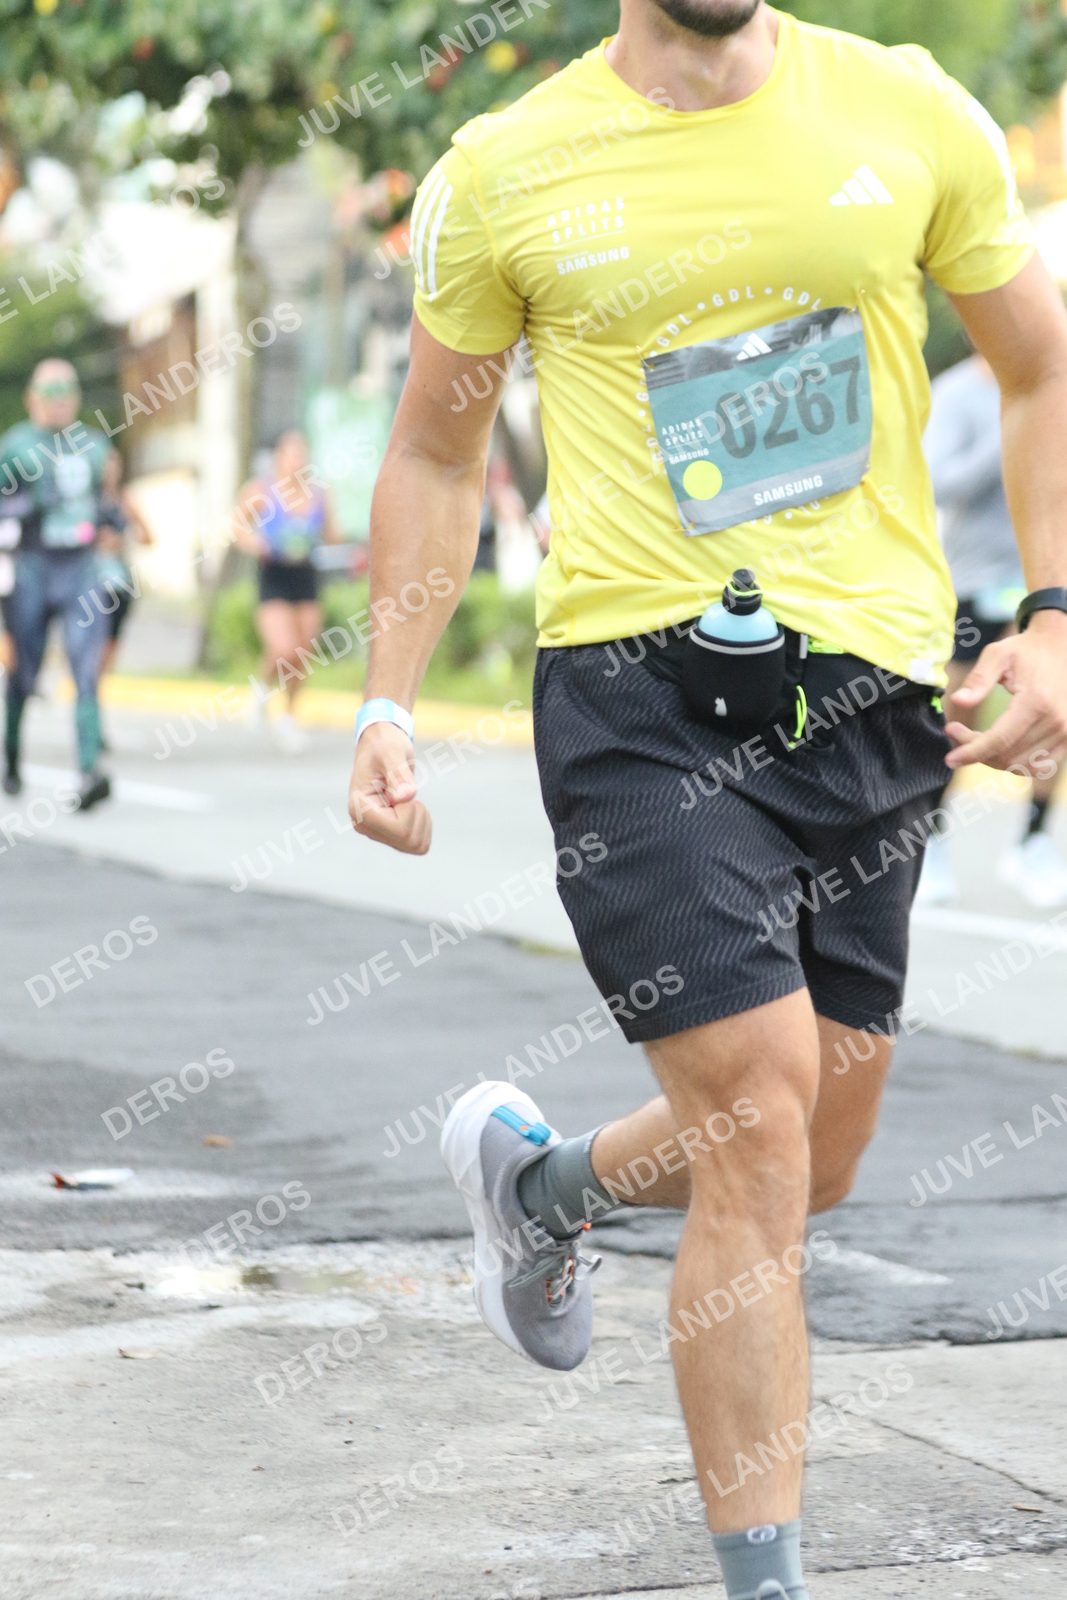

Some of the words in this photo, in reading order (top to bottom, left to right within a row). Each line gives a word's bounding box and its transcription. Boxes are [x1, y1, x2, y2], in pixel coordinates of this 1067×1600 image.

[551, 215, 625, 243] SPLITS
[556, 246, 631, 276] SAMSUNG
[656, 313, 692, 347] GDL
[712, 286, 755, 307] GDL
[782, 287, 822, 311] GDL
[715, 355, 862, 459] 0267
[668, 447, 710, 465] SAMSUNG
[753, 474, 823, 507] SAMSUNG
